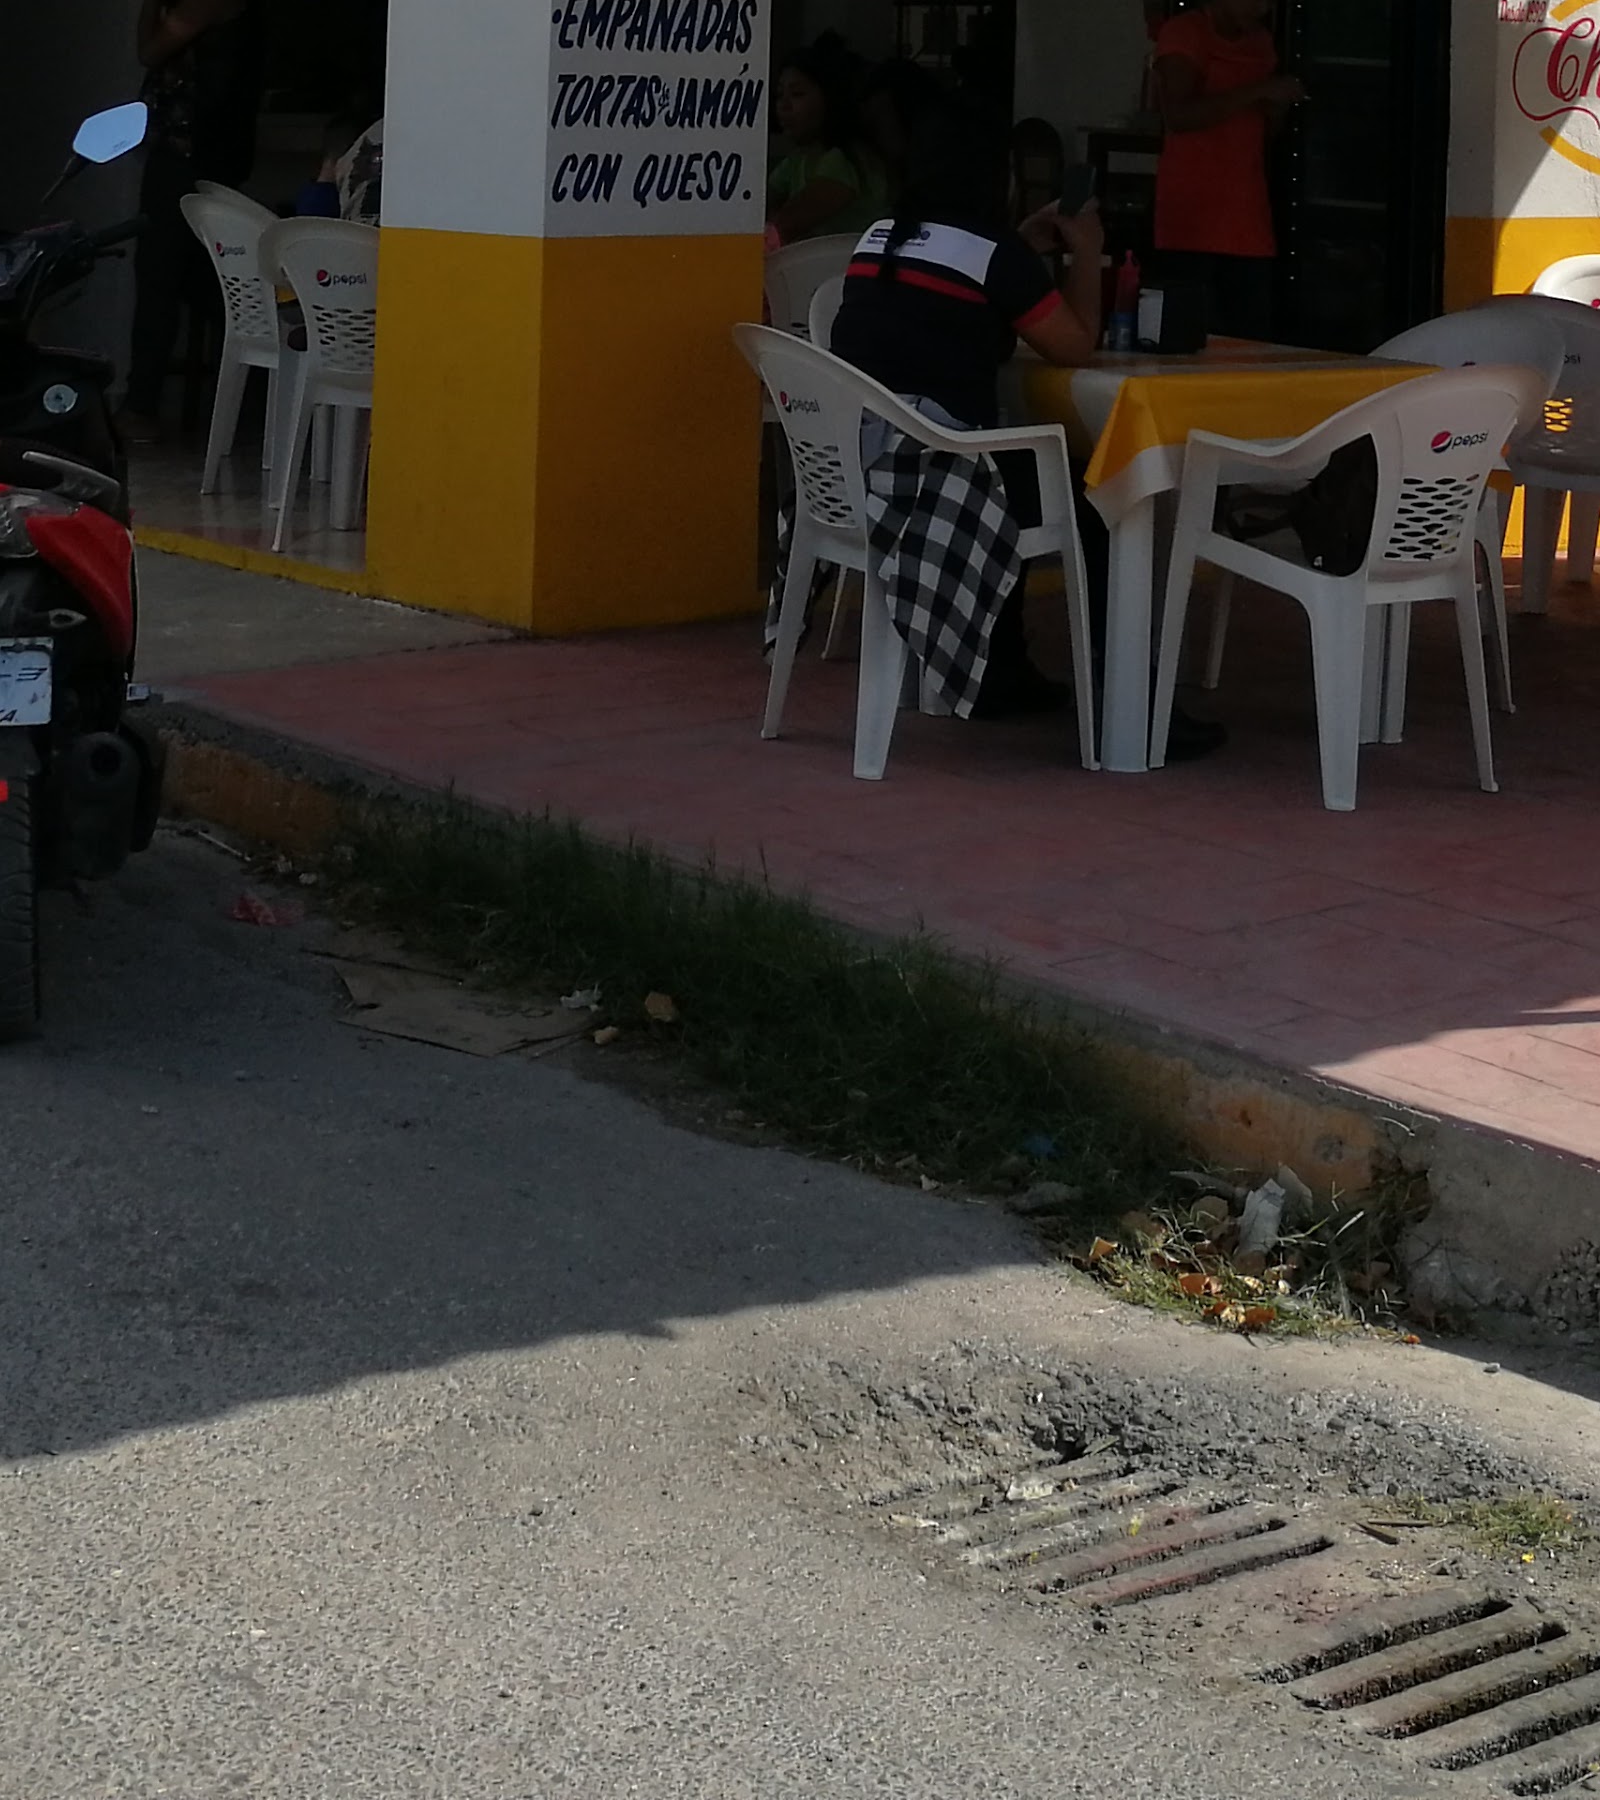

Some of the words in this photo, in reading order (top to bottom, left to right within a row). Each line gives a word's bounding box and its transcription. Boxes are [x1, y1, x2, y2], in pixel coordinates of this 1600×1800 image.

[551, 73, 660, 130] TORTAS
[664, 62, 764, 130] JAMÓN
[552, 152, 622, 204] CON
[633, 150, 752, 209] QUESO.
[332, 272, 368, 286] pepsi
[791, 397, 821, 415] pepsi
[1451, 429, 1489, 450] pepsi
